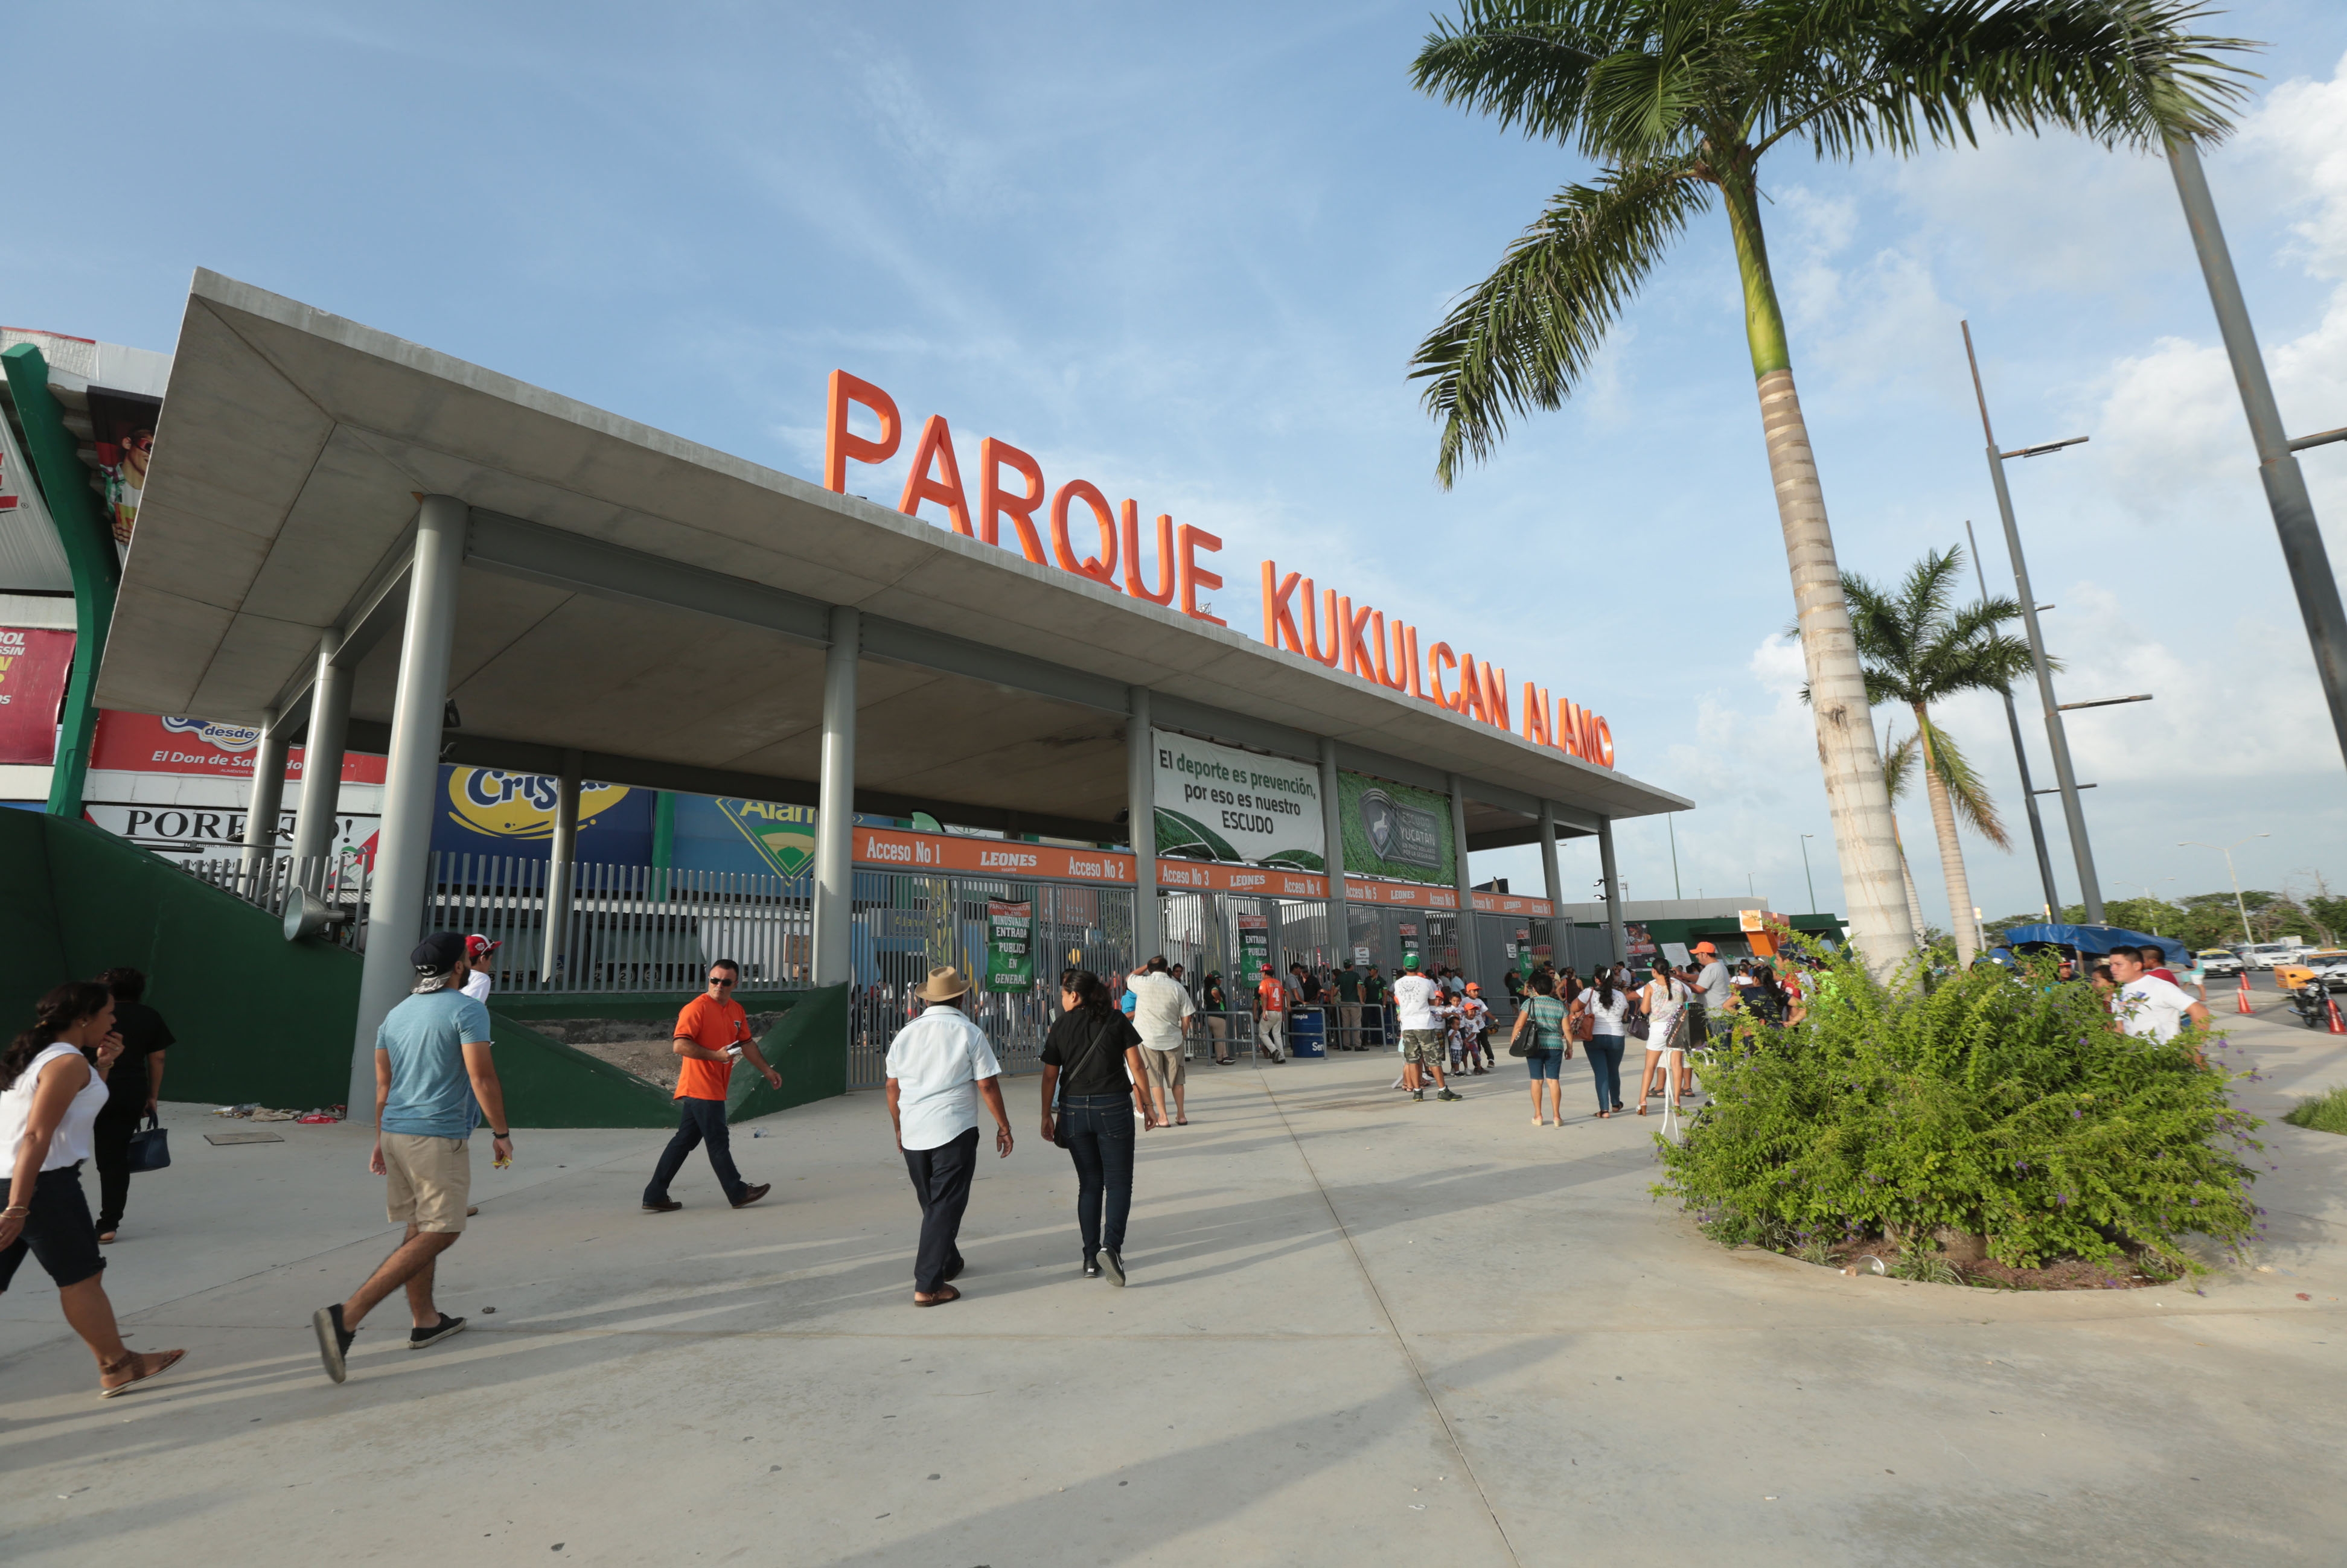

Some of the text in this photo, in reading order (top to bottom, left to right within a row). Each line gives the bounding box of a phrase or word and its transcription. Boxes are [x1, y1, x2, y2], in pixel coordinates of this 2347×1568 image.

[825, 369, 1615, 771] PARQUE KUKULCAN ALAMO
[205, 726, 254, 739] desde
[152, 750, 164, 761] El
[170, 751, 205, 764] Don
[208, 753, 227, 766] de
[1159, 749, 1316, 799] El deporte es prevención,
[1184, 783, 1301, 816] por eso es nuestro
[1221, 810, 1273, 835] ESCUDO
[1402, 812, 1430, 827] ESCUDO
[1400, 826, 1435, 846] YUCATÁN
[866, 836, 940, 864] Acceso No 1
[980, 852, 1037, 867] LEONES
[1068, 856, 1124, 879] Acceso No 2
[1163, 865, 1209, 886] Acceso No 3
[1230, 875, 1265, 887] LEONES
[1284, 878, 1321, 895] Acceso No 4
[1346, 884, 1377, 900] Acceso No 5
[1390, 890, 1415, 900] LEONES
[1429, 892, 1445, 905] Acceso
[1445, 893, 1451, 906] No
[1504, 901, 1521, 910] LEONES
[996, 926, 1027, 939] ENTRADA
[1245, 935, 1267, 945] ENTRADA
[998, 942, 1025, 954] PUBLICO
[1248, 948, 1267, 957] PUBLICO
[1009, 958, 1017, 969] EN
[995, 974, 1027, 985] GENERAL
[1272, 987, 1280, 1001] 4
